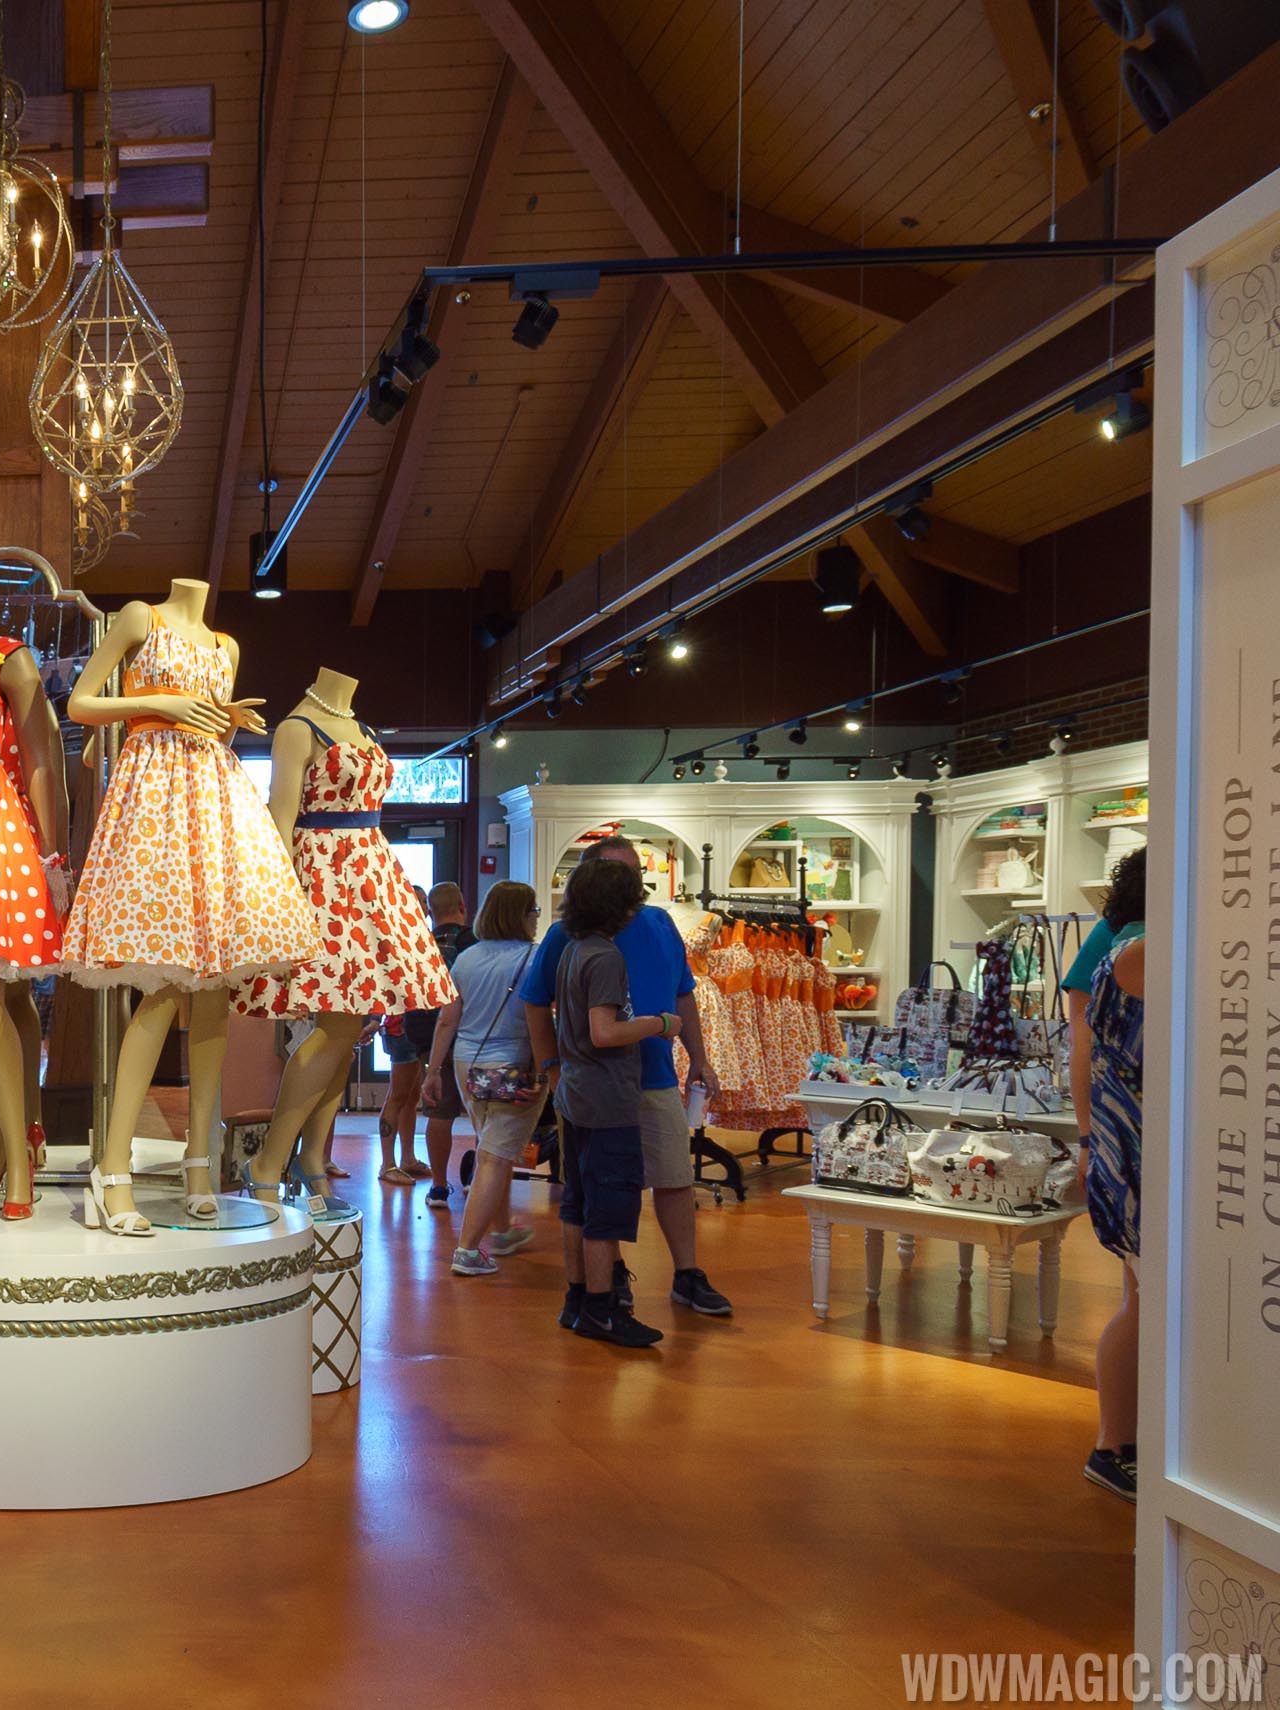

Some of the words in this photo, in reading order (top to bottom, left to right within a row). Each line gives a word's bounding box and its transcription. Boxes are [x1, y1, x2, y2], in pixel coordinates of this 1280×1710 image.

[1221, 777, 1253, 910] SHOP
[1219, 940, 1251, 1101] DRESS
[1216, 1127, 1248, 1231] THE
[1260, 1252, 1280, 1335] ON
